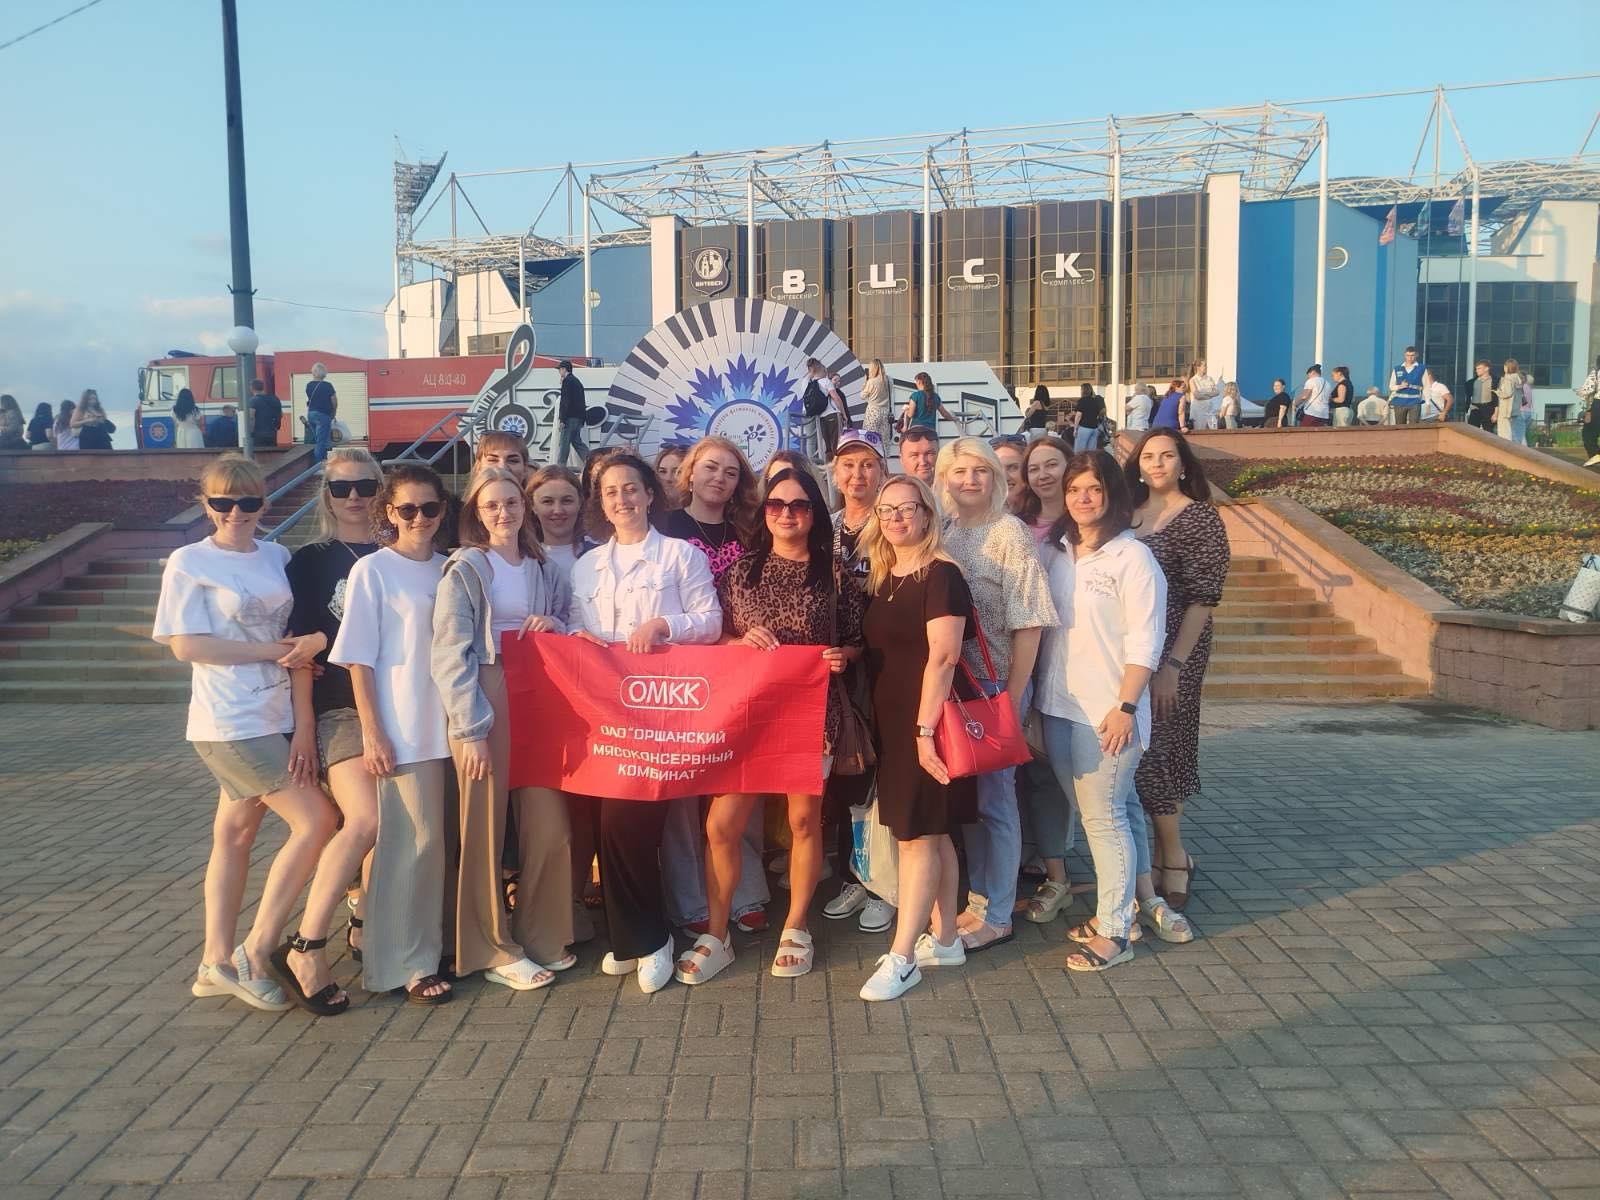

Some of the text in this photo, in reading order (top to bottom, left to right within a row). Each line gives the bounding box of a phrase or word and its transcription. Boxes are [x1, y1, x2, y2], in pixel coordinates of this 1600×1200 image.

[783, 253, 1081, 293] В Ц С К
[1049, 278, 1085, 287] КОМПЛЕКС
[628, 681, 700, 705] ОМКК
[600, 725, 626, 739] ОАО
[593, 743, 733, 765] МЯСОКОНСЕРВНЫЙ
